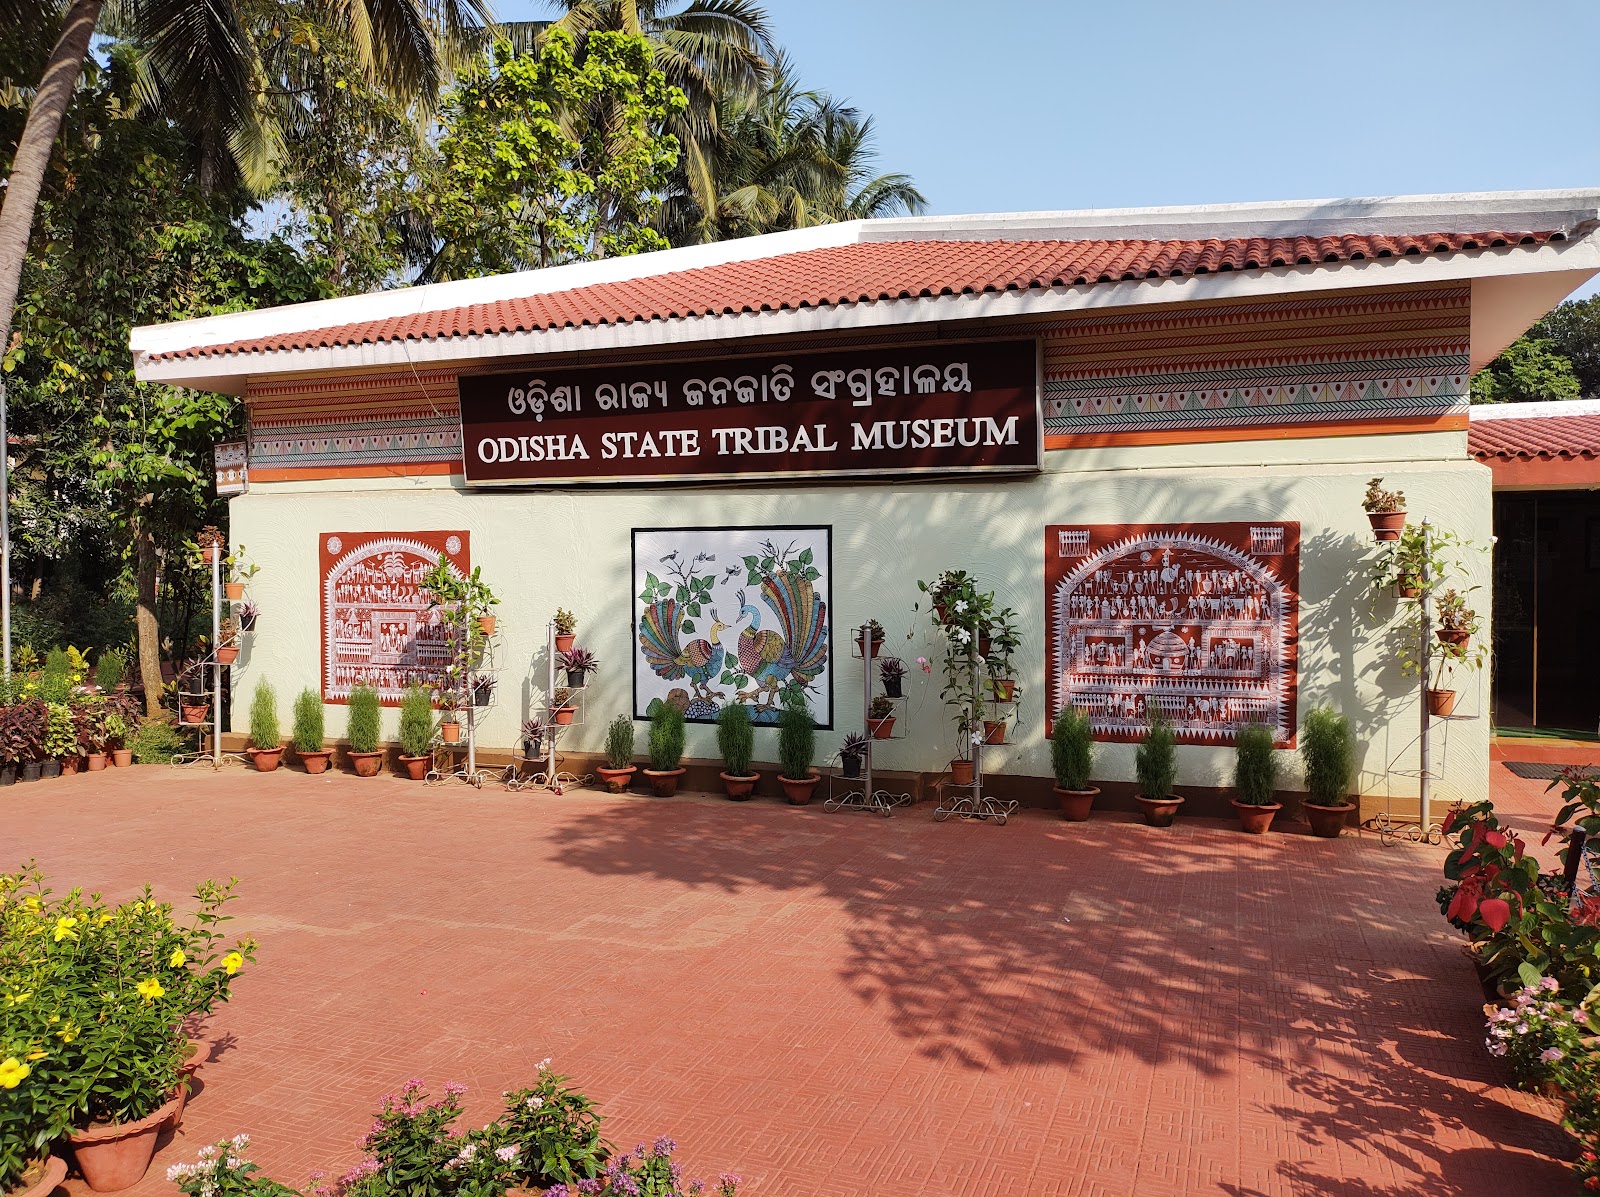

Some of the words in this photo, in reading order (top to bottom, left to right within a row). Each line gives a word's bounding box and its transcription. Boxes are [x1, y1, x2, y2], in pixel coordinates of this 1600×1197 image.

[508, 379, 581, 422] ଓଡ଼ିଶା
[595, 380, 668, 411] ରାଜ୍ୟ
[682, 363, 795, 406] ଜନଜାତି
[811, 362, 972, 407] ସଂଗ୍ରହାଳୟ
[477, 434, 590, 464] ODISHA
[601, 427, 701, 460] STATE
[711, 423, 838, 455] TRIBAL
[850, 416, 1019, 451] MUSEUM
